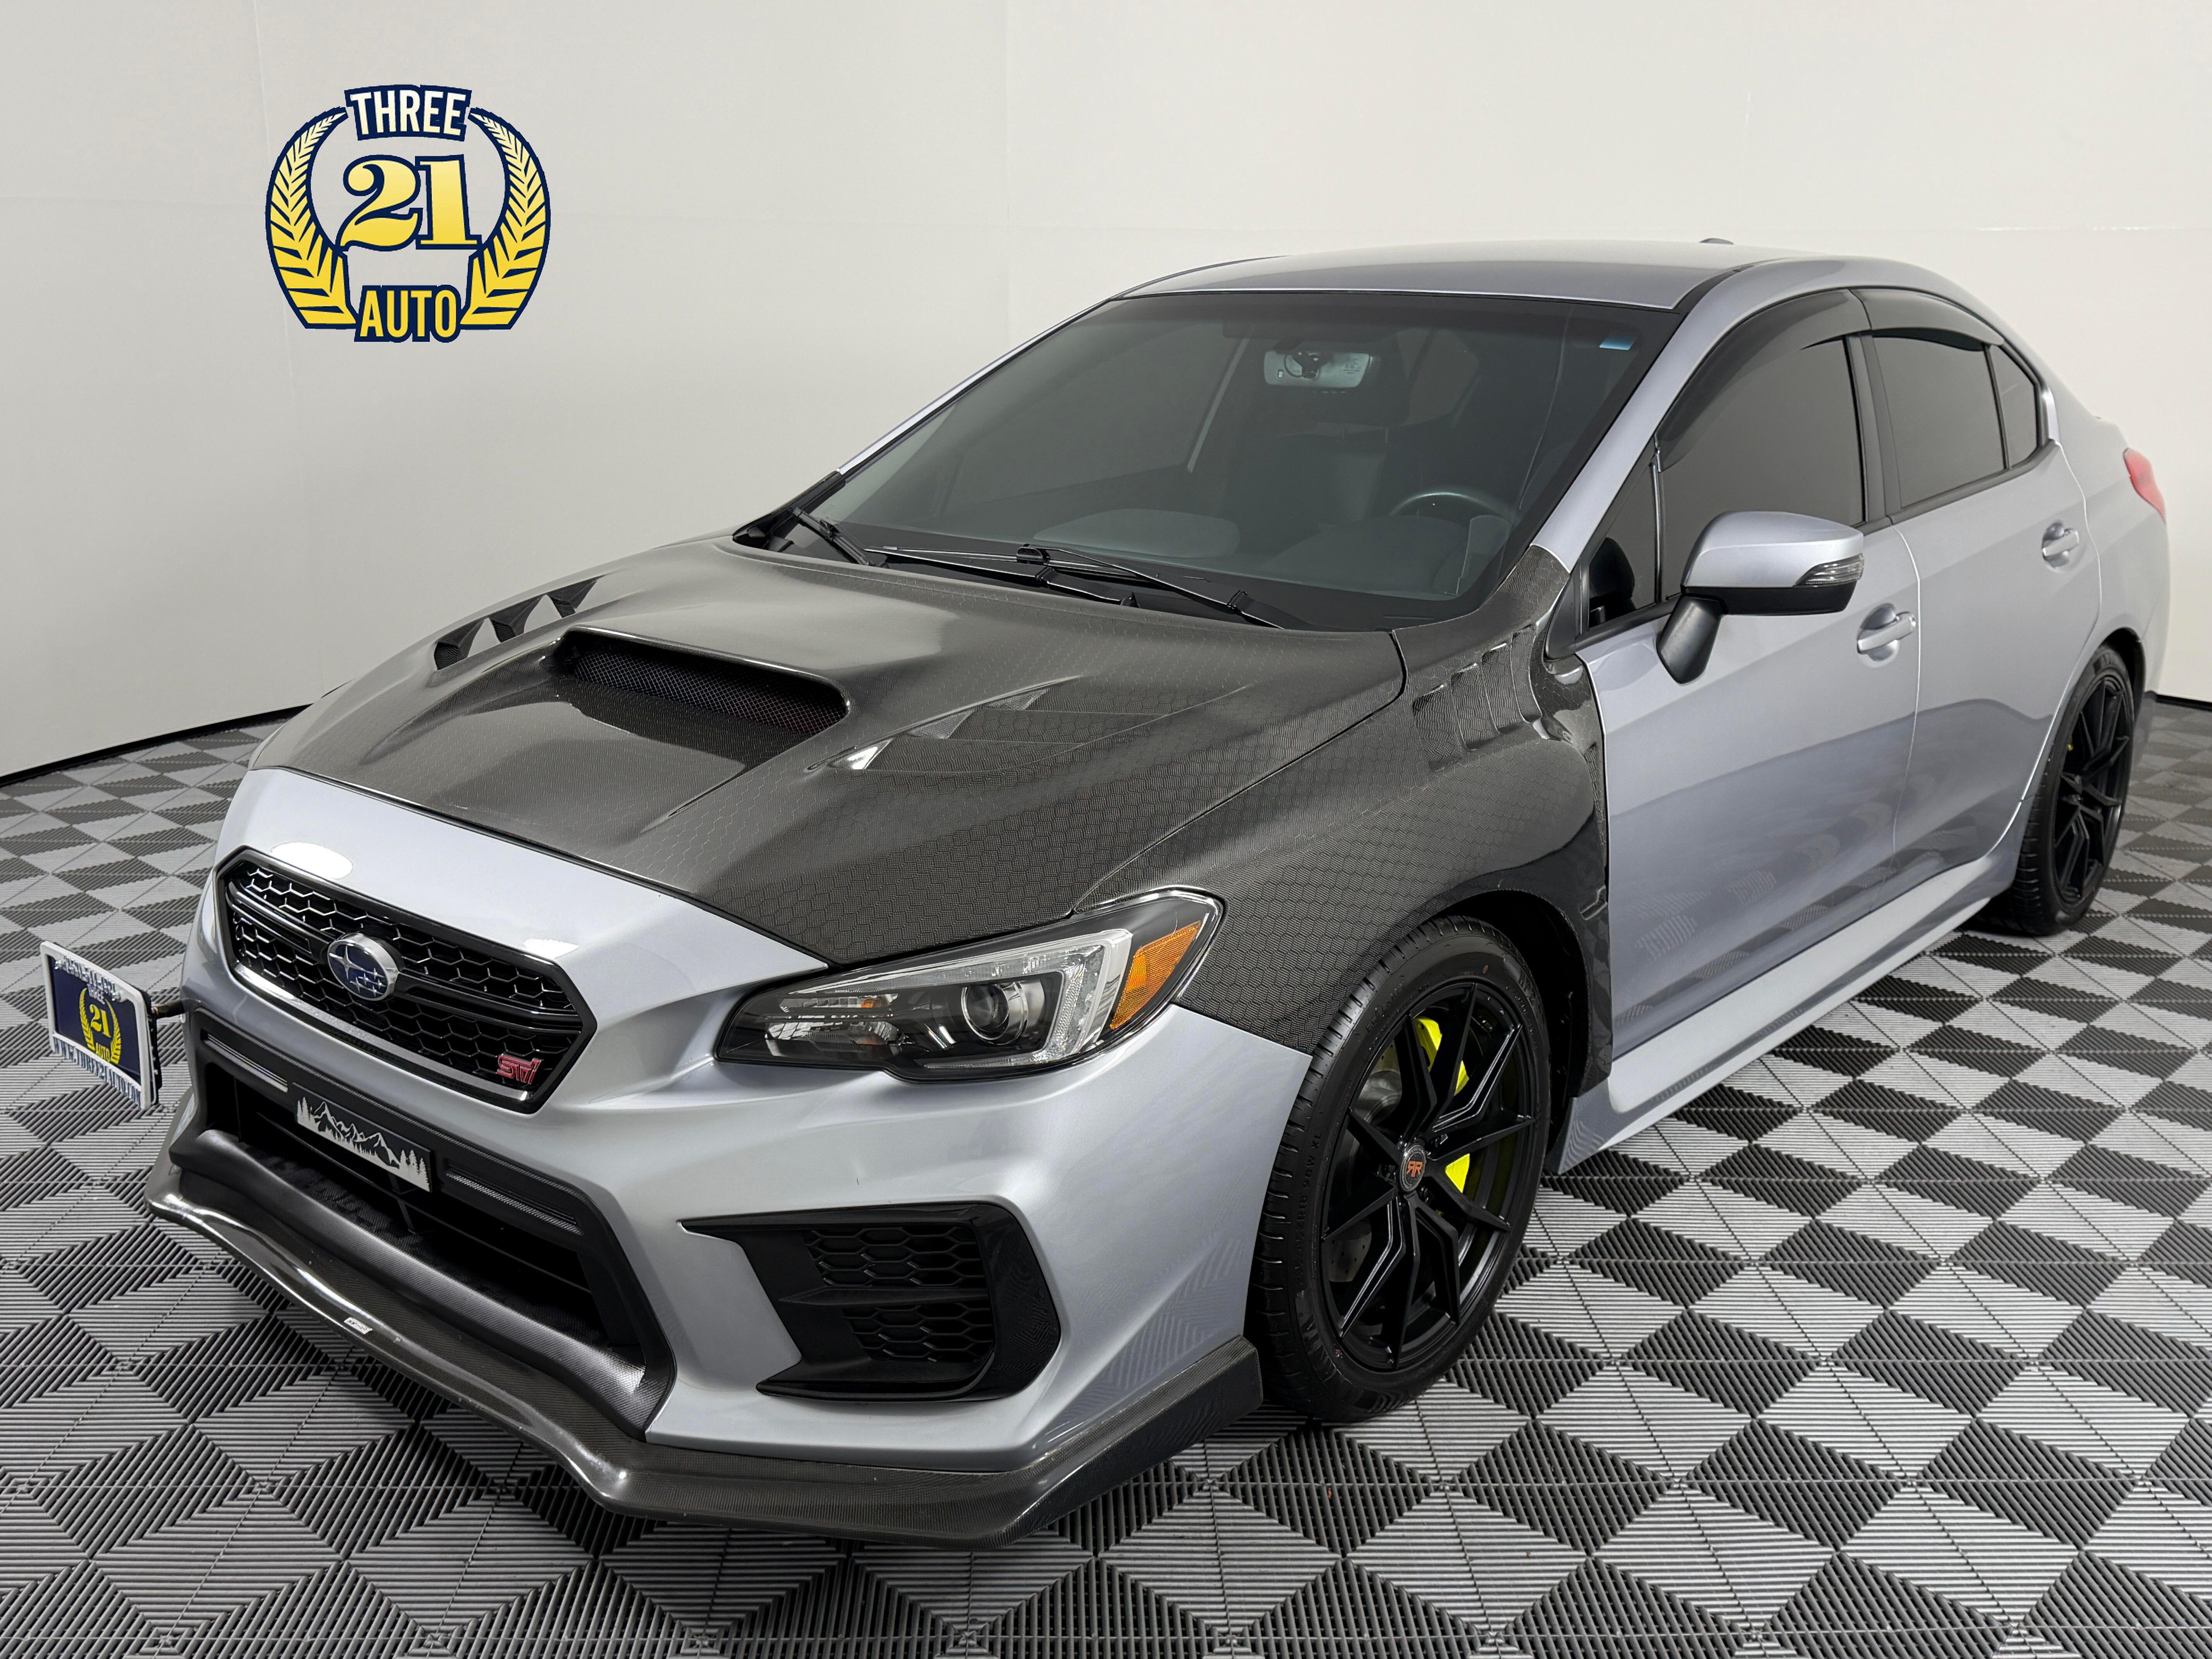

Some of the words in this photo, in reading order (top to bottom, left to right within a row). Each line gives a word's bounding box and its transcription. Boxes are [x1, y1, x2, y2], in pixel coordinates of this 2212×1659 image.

[89, 1004, 111, 1038] 21
[96, 1042, 110, 1062] AUTO
[1302, 1155, 1316, 1188] 98W
[1311, 1132, 1322, 1149] XL
